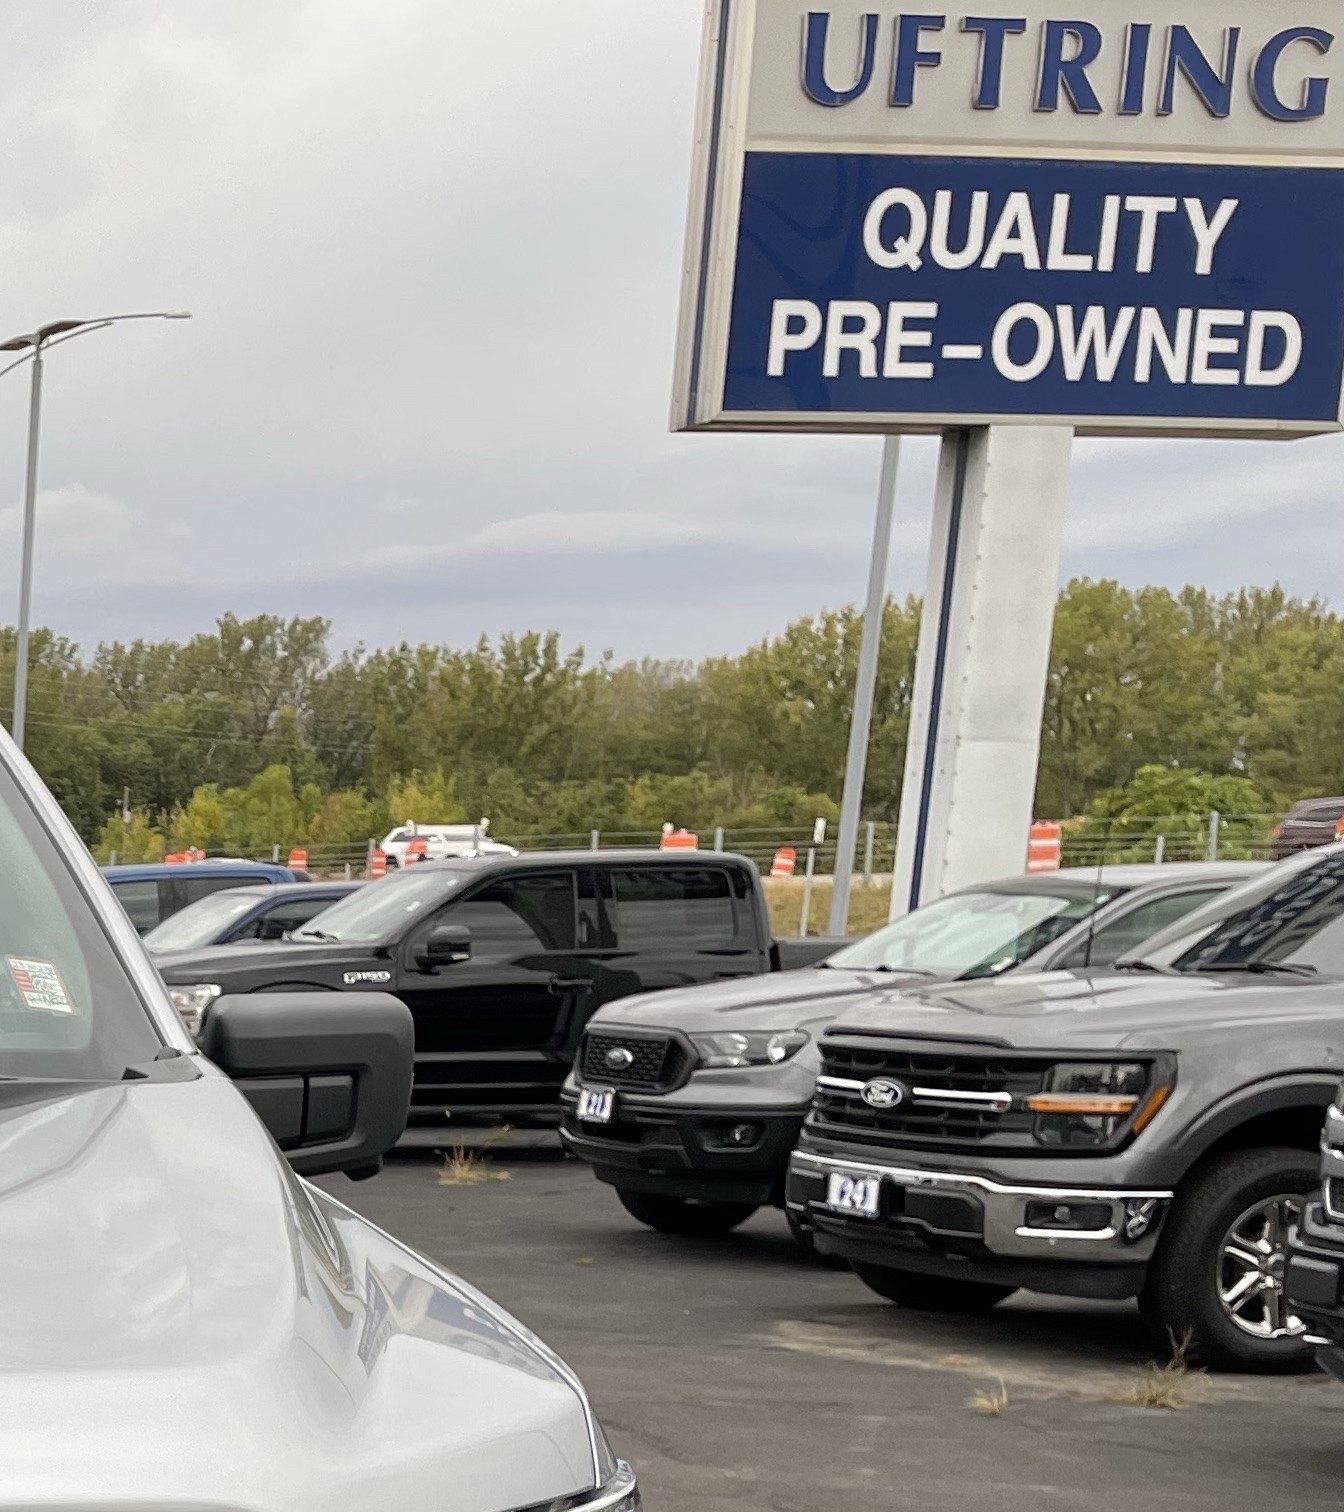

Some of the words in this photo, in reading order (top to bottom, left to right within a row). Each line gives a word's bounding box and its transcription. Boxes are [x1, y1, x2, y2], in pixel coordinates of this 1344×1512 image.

[800, 10, 1336, 122] UFTRING
[862, 186, 1239, 277] QUALITY
[766, 298, 1303, 387] PRE-OWNED
